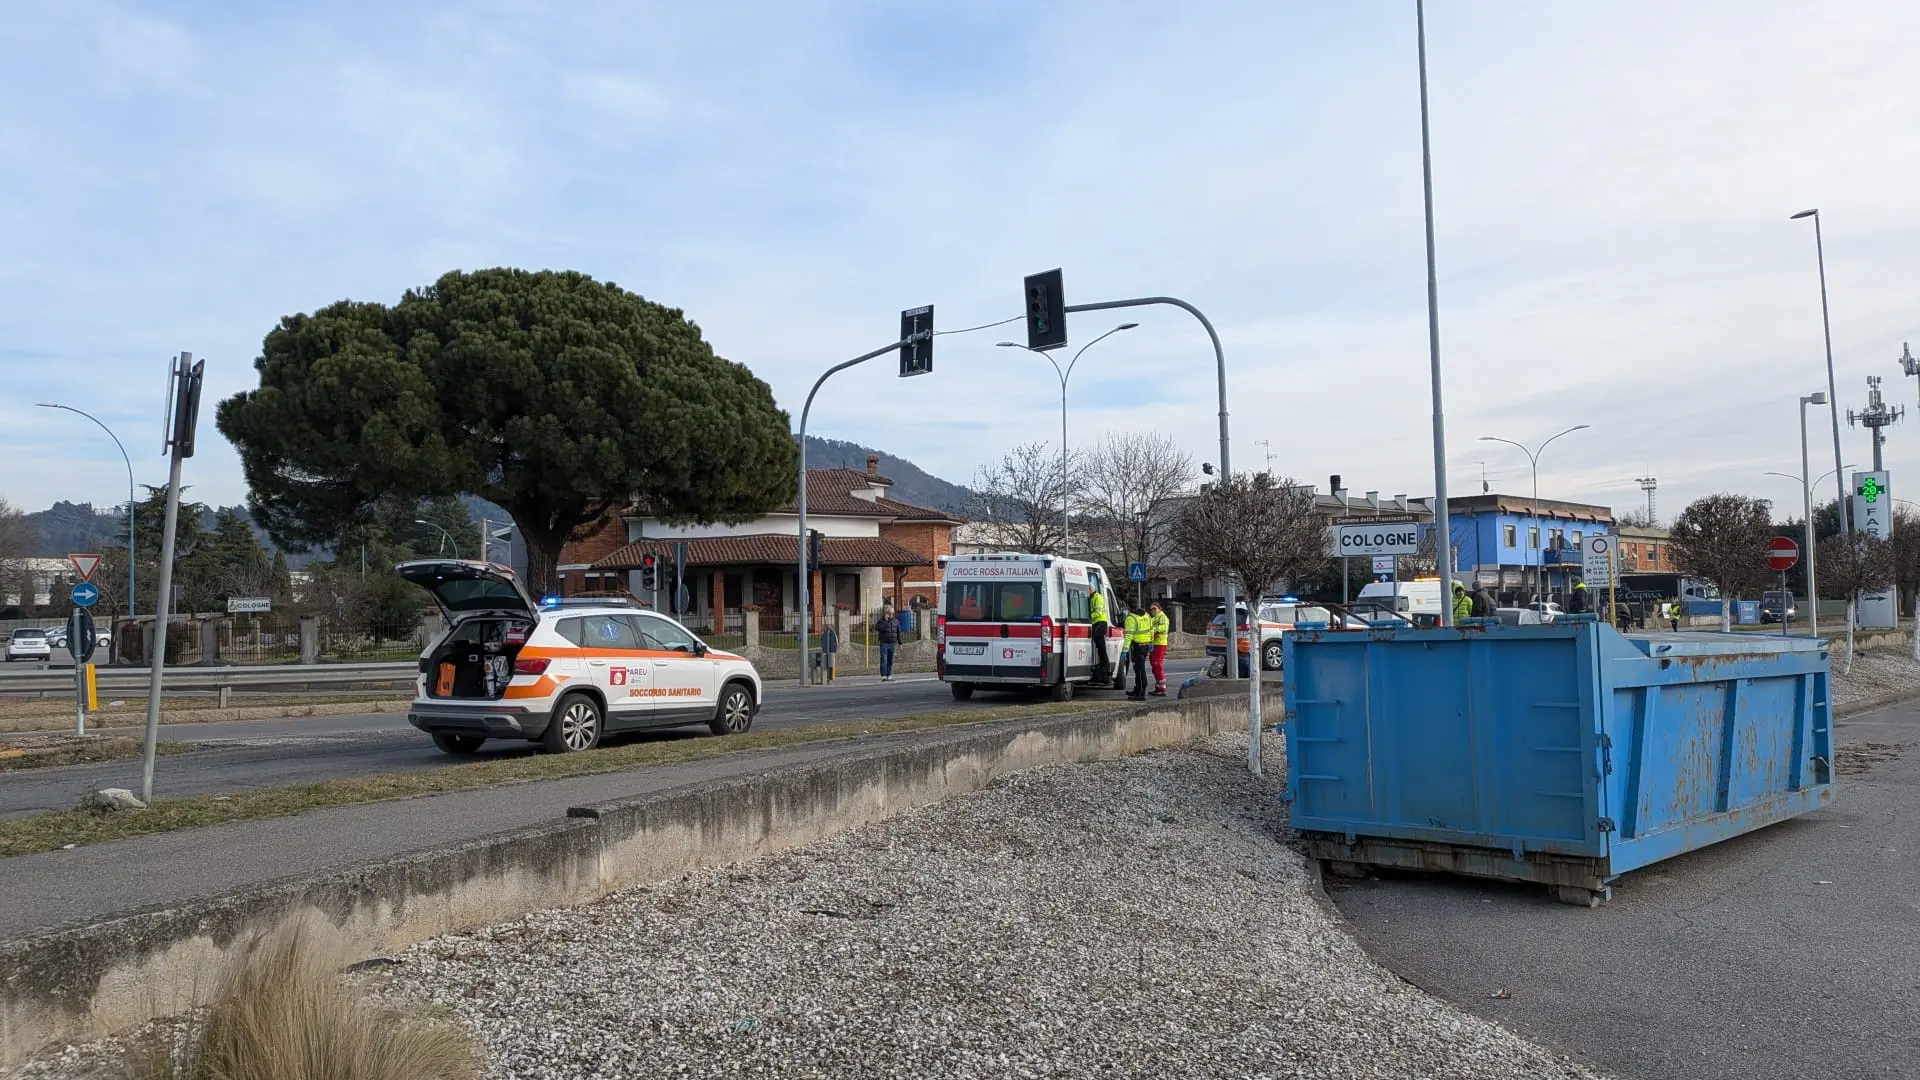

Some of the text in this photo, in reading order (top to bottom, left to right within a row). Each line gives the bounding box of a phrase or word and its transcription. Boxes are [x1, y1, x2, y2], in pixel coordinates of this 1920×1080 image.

[1341, 533, 1416, 546] COLOGNE
[953, 567, 1039, 576] CROCE ROSSA ITALIANA
[630, 687, 701, 697] SOCCORSO SANITARIO
